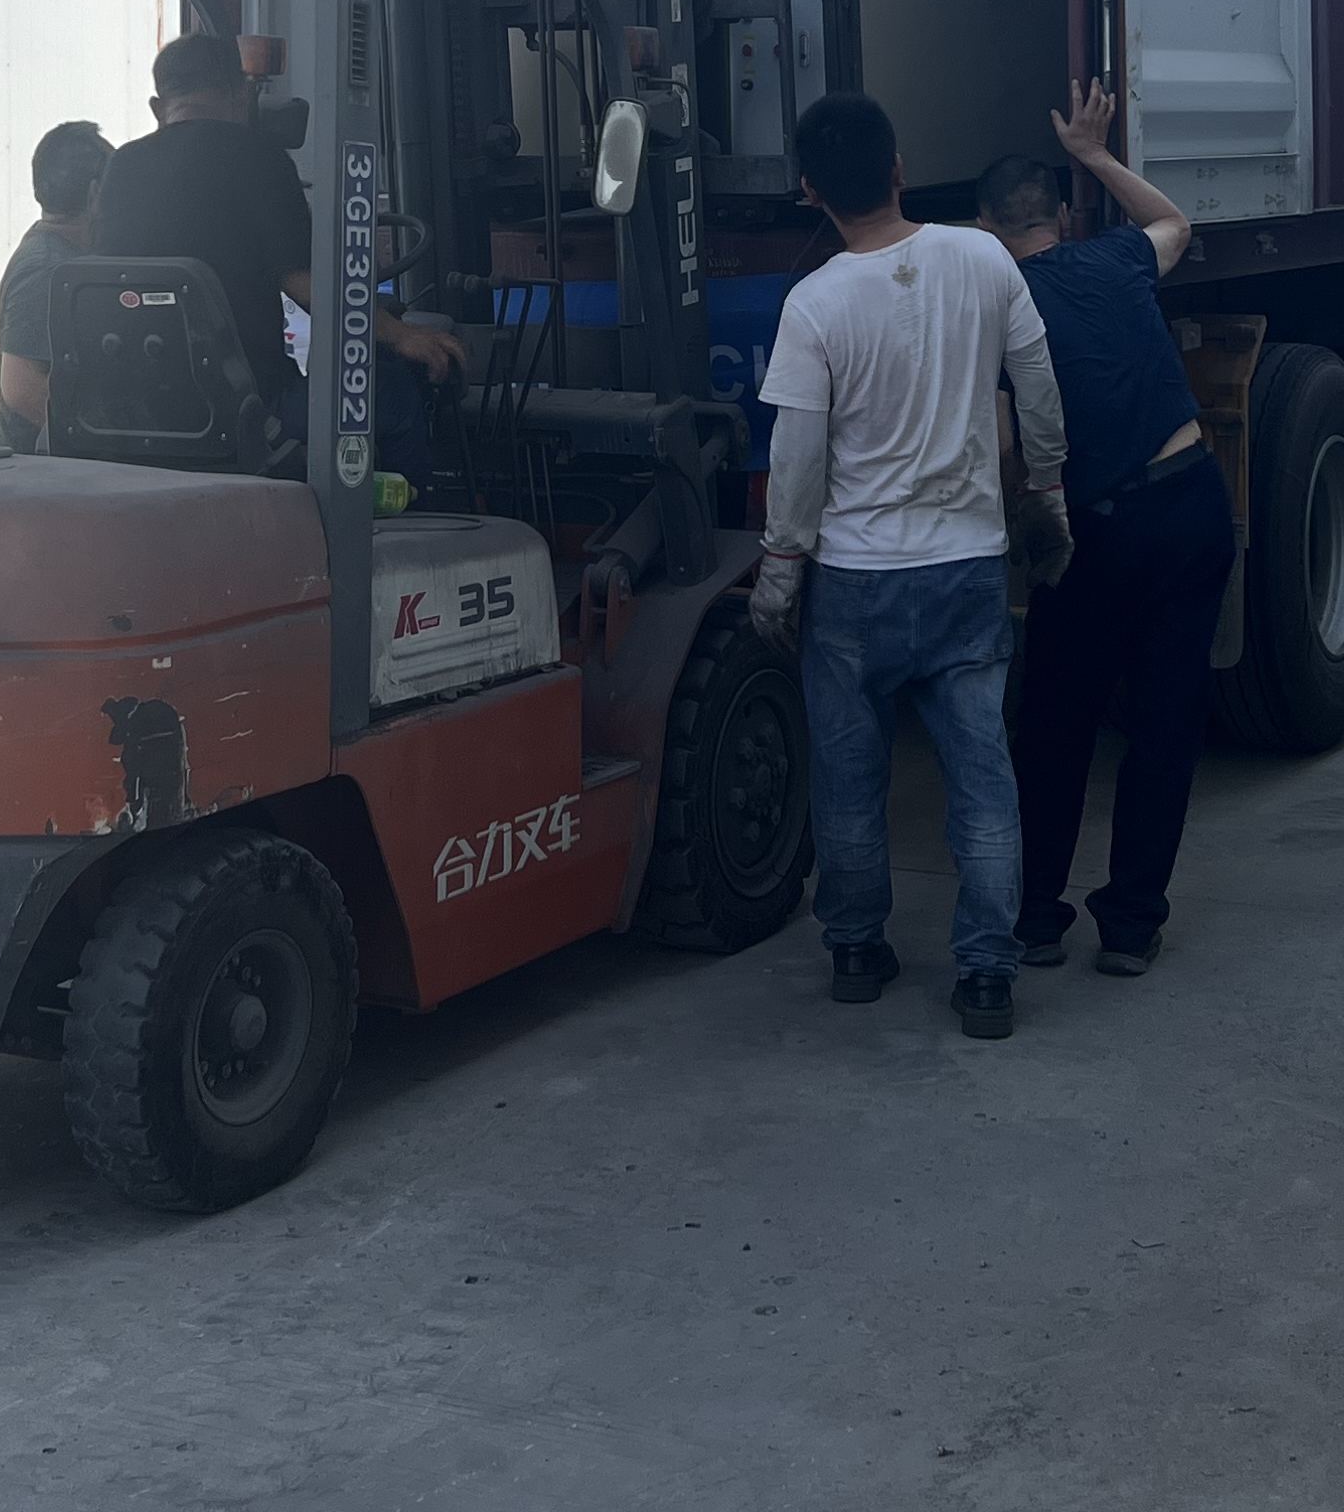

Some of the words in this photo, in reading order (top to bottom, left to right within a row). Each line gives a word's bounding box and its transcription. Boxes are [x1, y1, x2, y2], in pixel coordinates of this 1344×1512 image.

[342, 153, 372, 423] 3-GE300692
[675, 156, 700, 307] HELI
[458, 575, 515, 627] 35
[433, 794, 581, 903] 合力叉车
